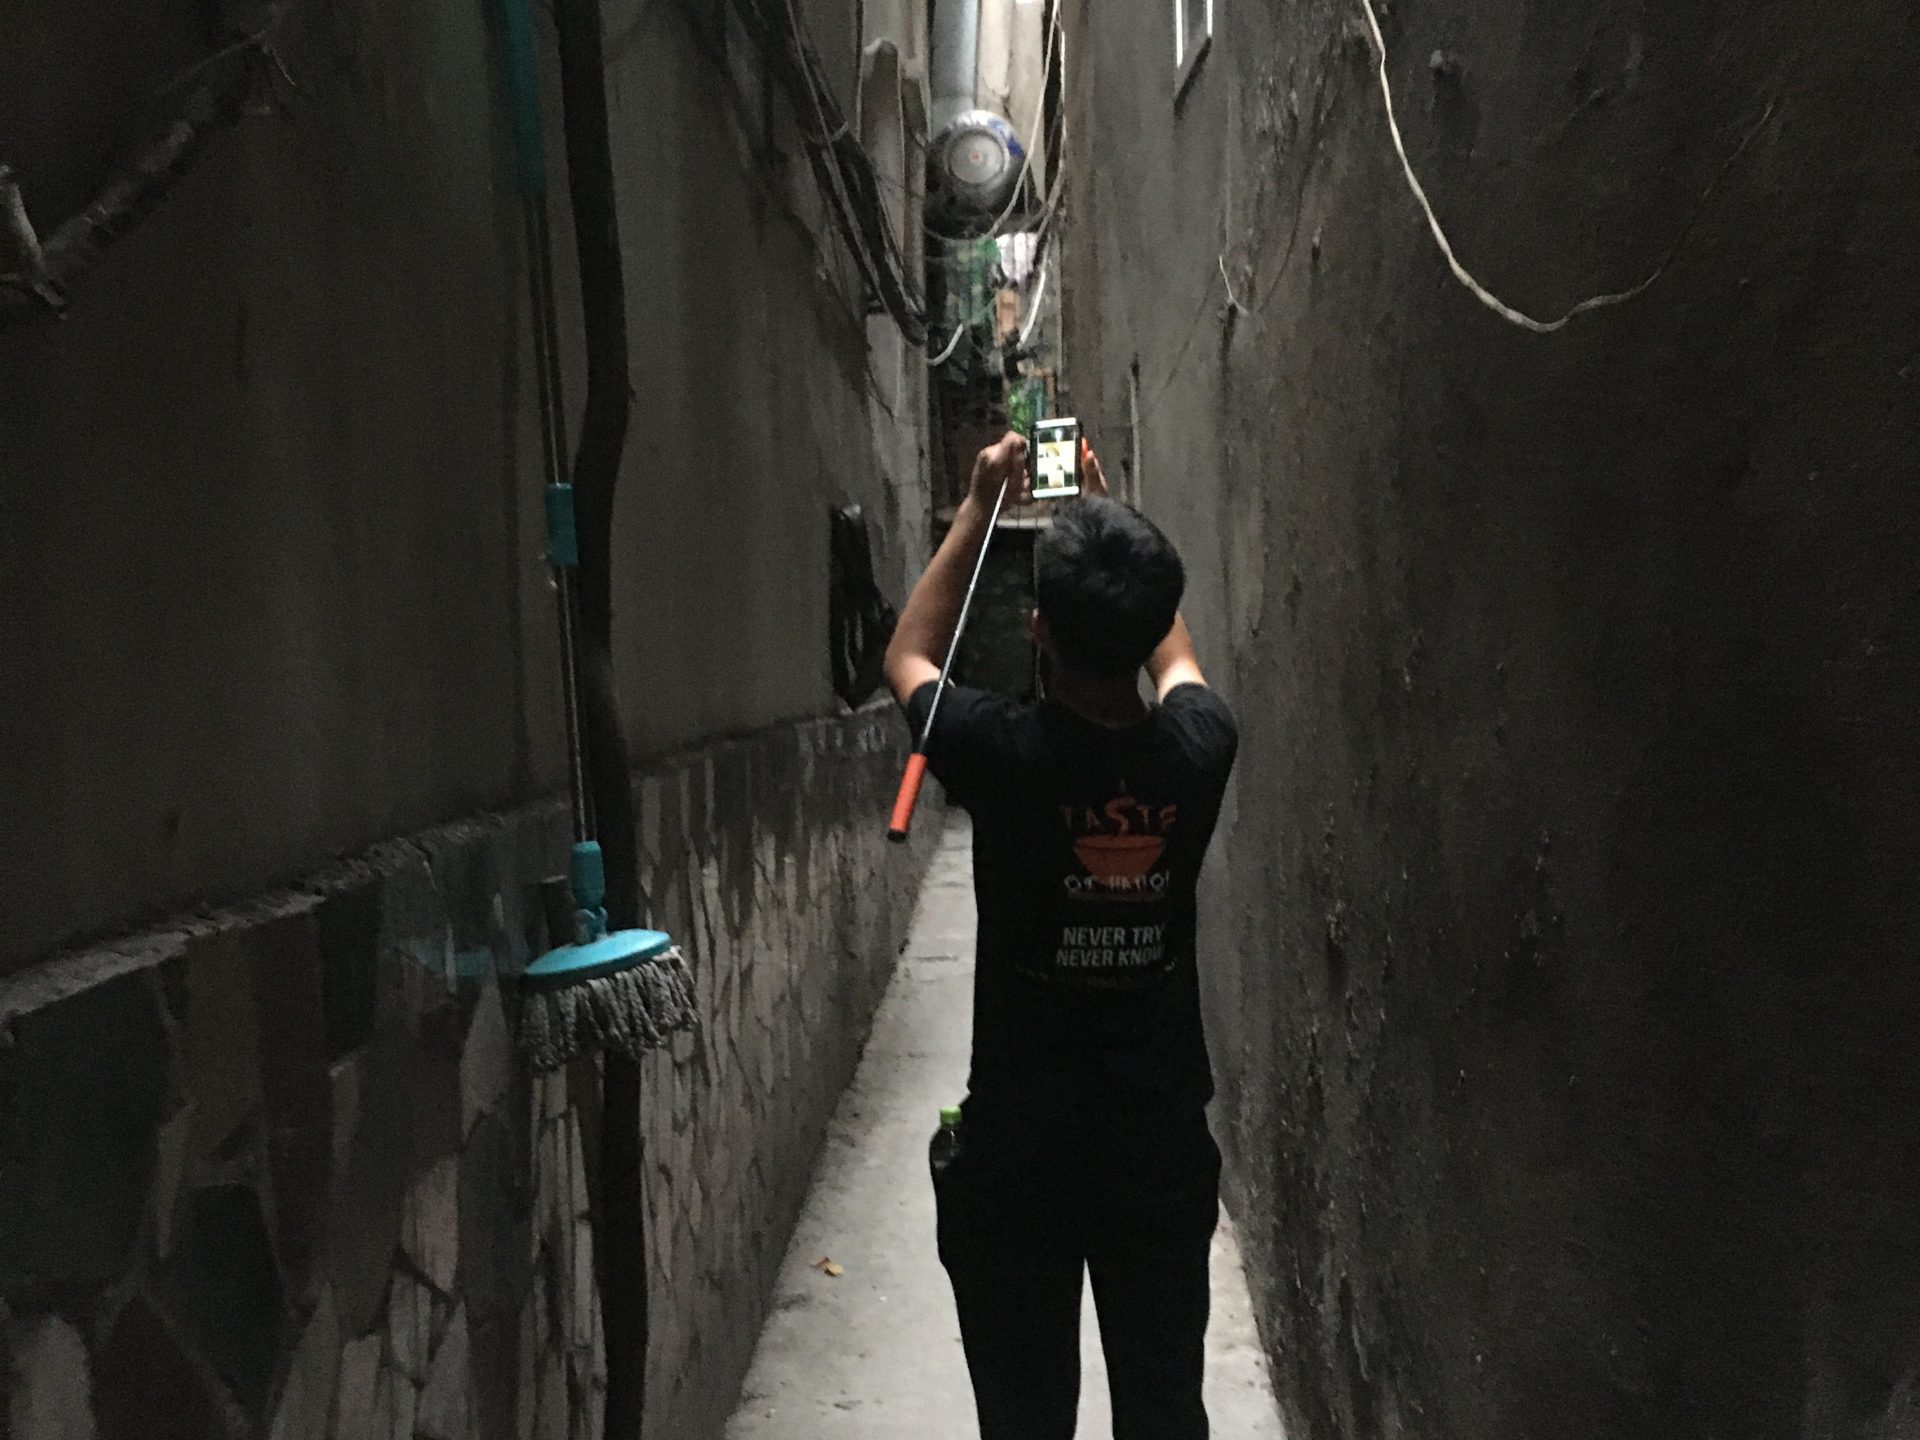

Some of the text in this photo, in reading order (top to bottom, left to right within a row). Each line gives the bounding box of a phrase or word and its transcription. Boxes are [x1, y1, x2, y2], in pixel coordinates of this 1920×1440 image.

[1063, 923, 1165, 946] NEVER TRY
[1056, 949, 1113, 967] NEVER
